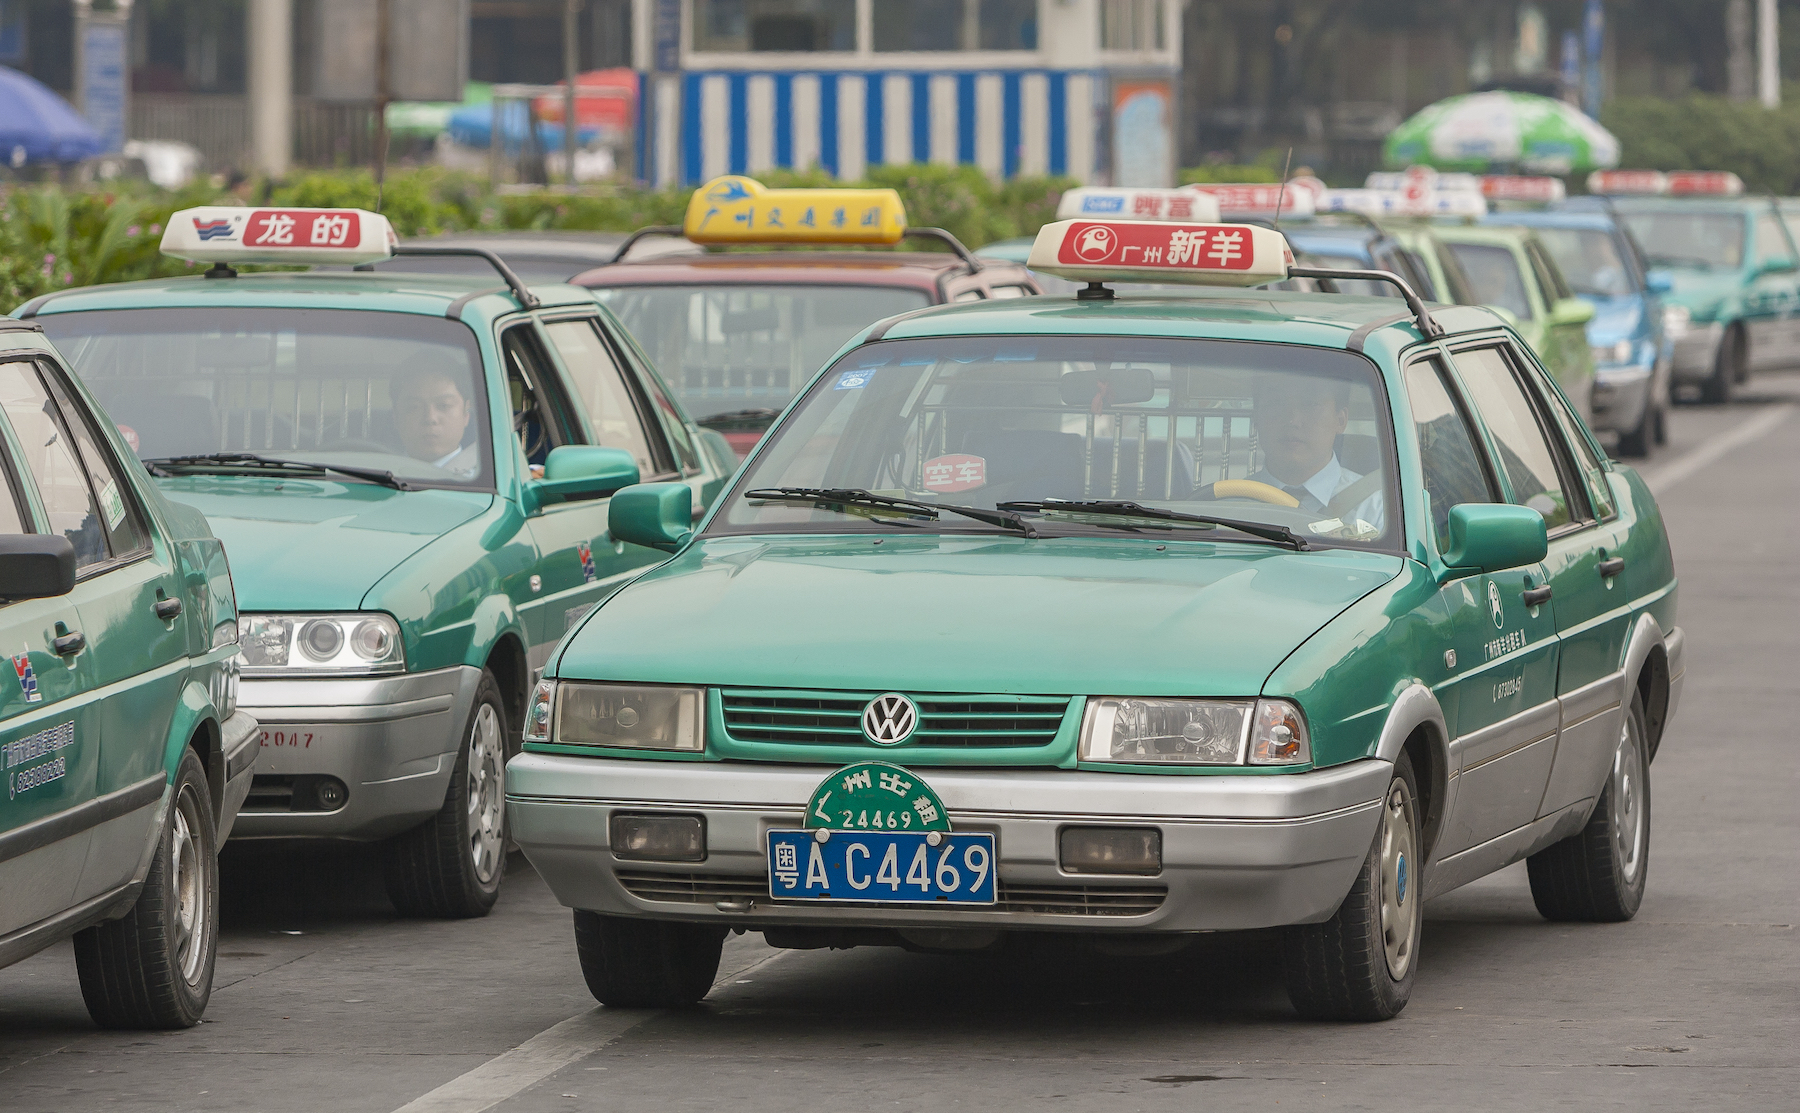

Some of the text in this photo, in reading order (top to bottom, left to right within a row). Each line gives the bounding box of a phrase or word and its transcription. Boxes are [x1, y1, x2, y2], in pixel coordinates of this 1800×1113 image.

[256, 214, 349, 245] 龙的
[926, 462, 983, 486] 空车
[863, 693, 916, 744] VW
[16, 756, 66, 794] 82388222
[815, 769, 939, 826] 广州出租
[842, 810, 912, 828] 24469
